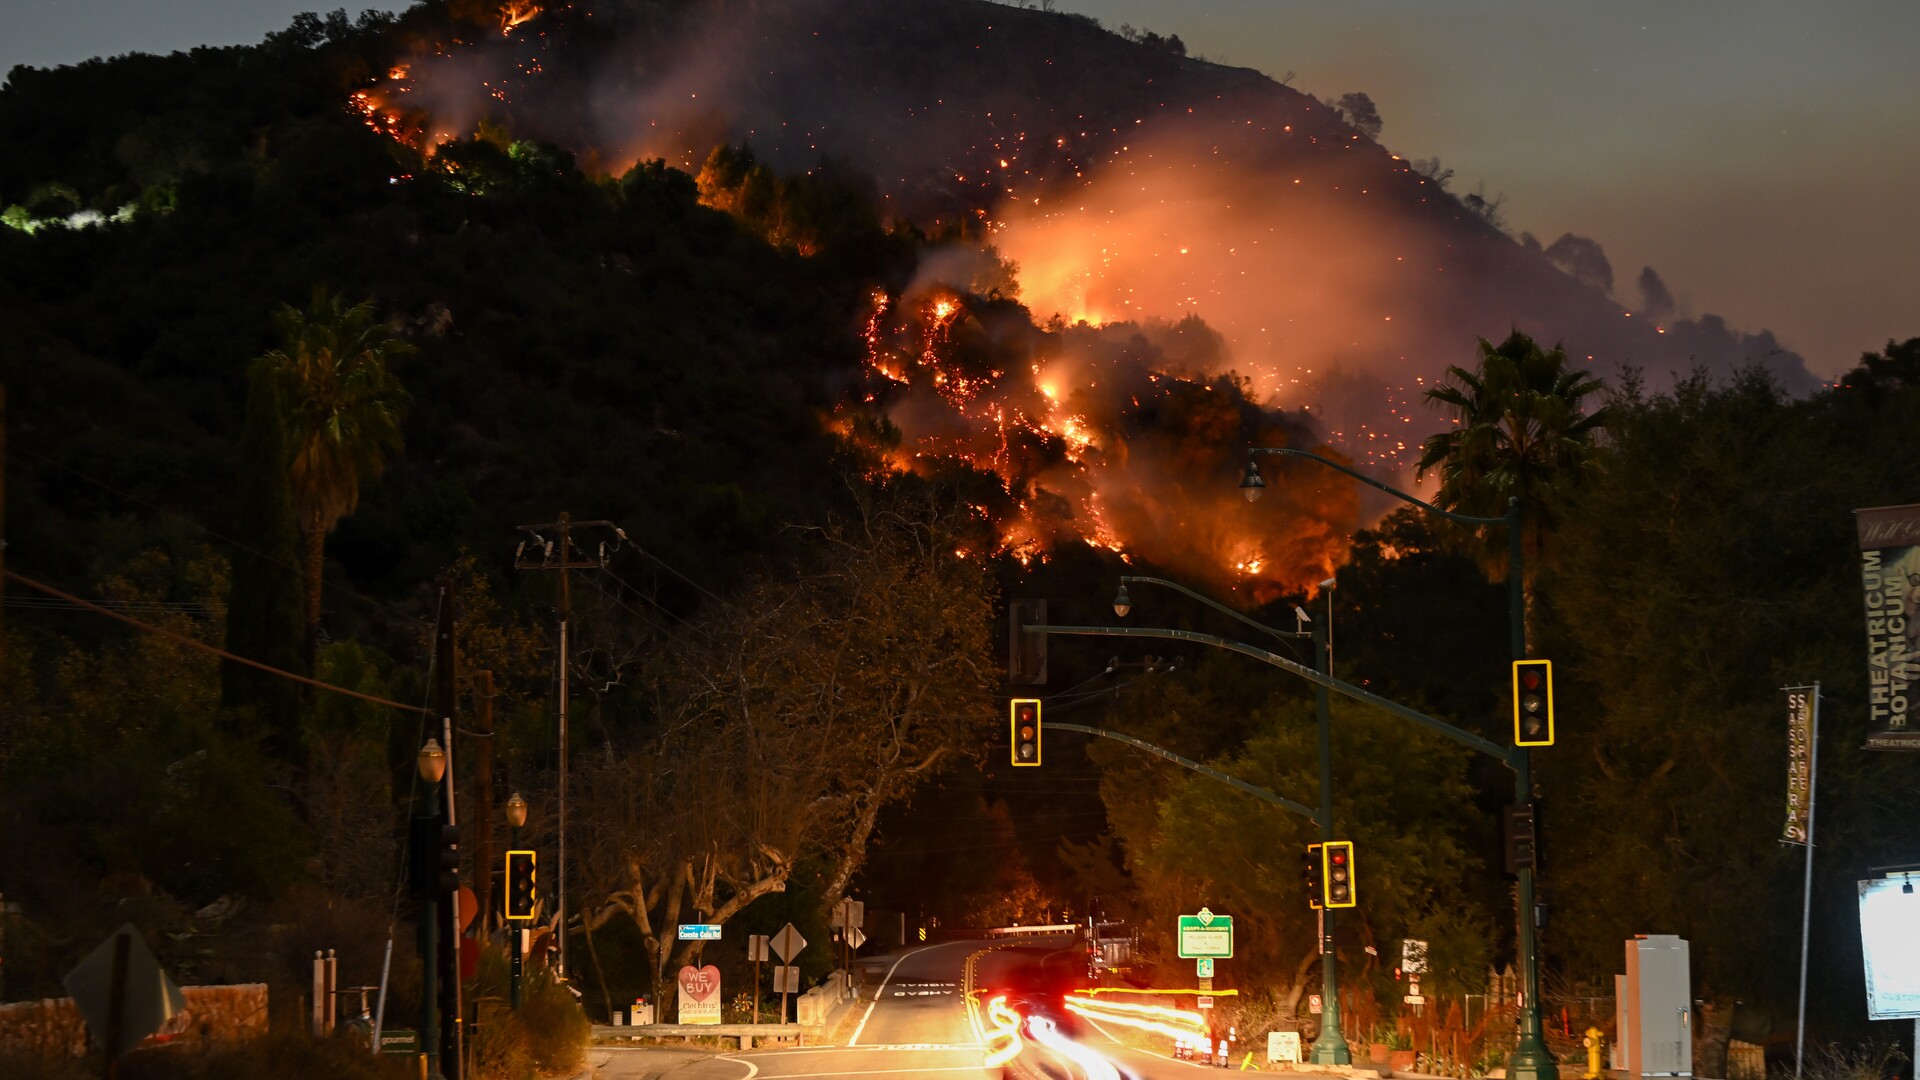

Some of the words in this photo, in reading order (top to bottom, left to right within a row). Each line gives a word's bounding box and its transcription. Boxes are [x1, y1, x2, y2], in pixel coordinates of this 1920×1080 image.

[1862, 518, 1902, 542] Will
[1861, 549, 1889, 721] THEATRICUM
[1885, 576, 1907, 731] BOTANICUM
[1868, 738, 1920, 747] THEATRIC
[1784, 694, 1799, 839] SASSAFRAS
[686, 982, 712, 993] BUY
[688, 972, 708, 982] WE
